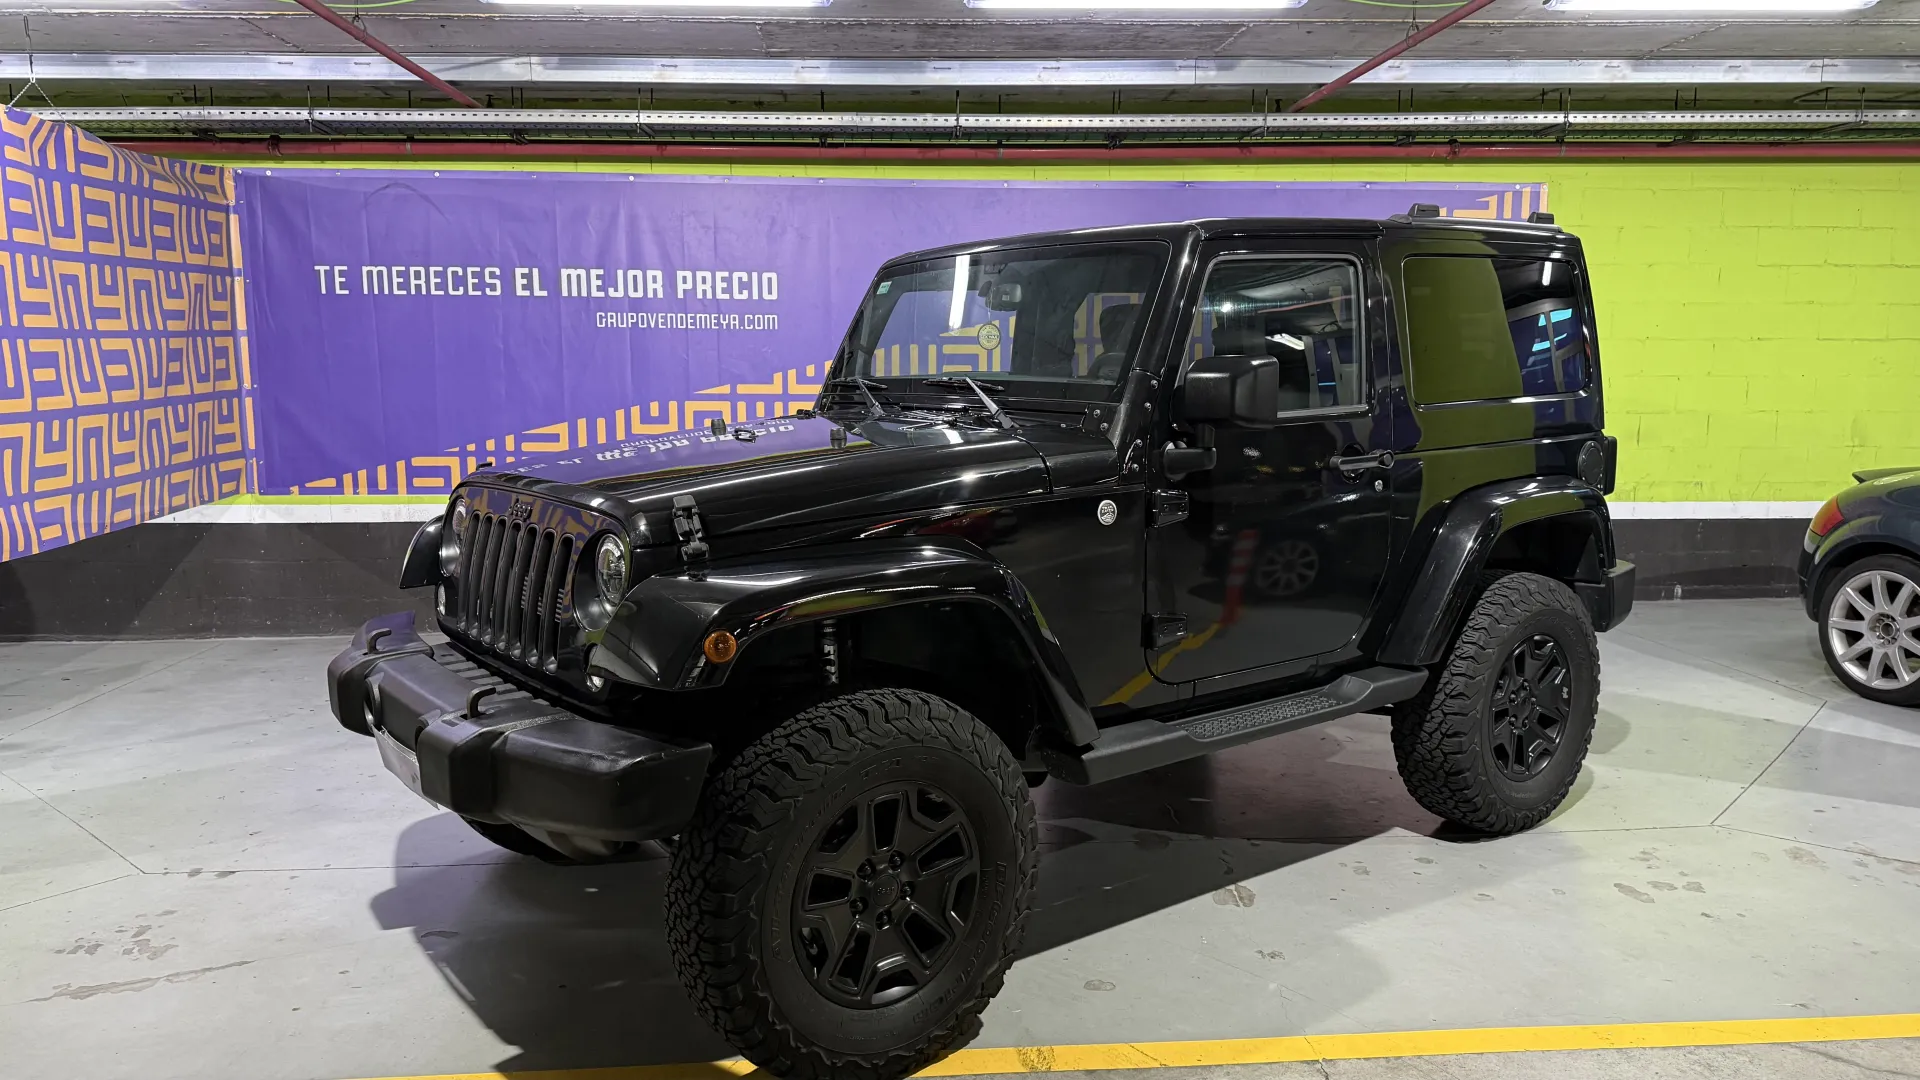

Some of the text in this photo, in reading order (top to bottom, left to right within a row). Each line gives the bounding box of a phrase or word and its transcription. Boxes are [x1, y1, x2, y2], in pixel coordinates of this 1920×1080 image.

[314, 265, 778, 301] TE MERECES EL MEJOR PRECIO
[596, 311, 778, 330] GRUPOVENDEMEYA.COM
